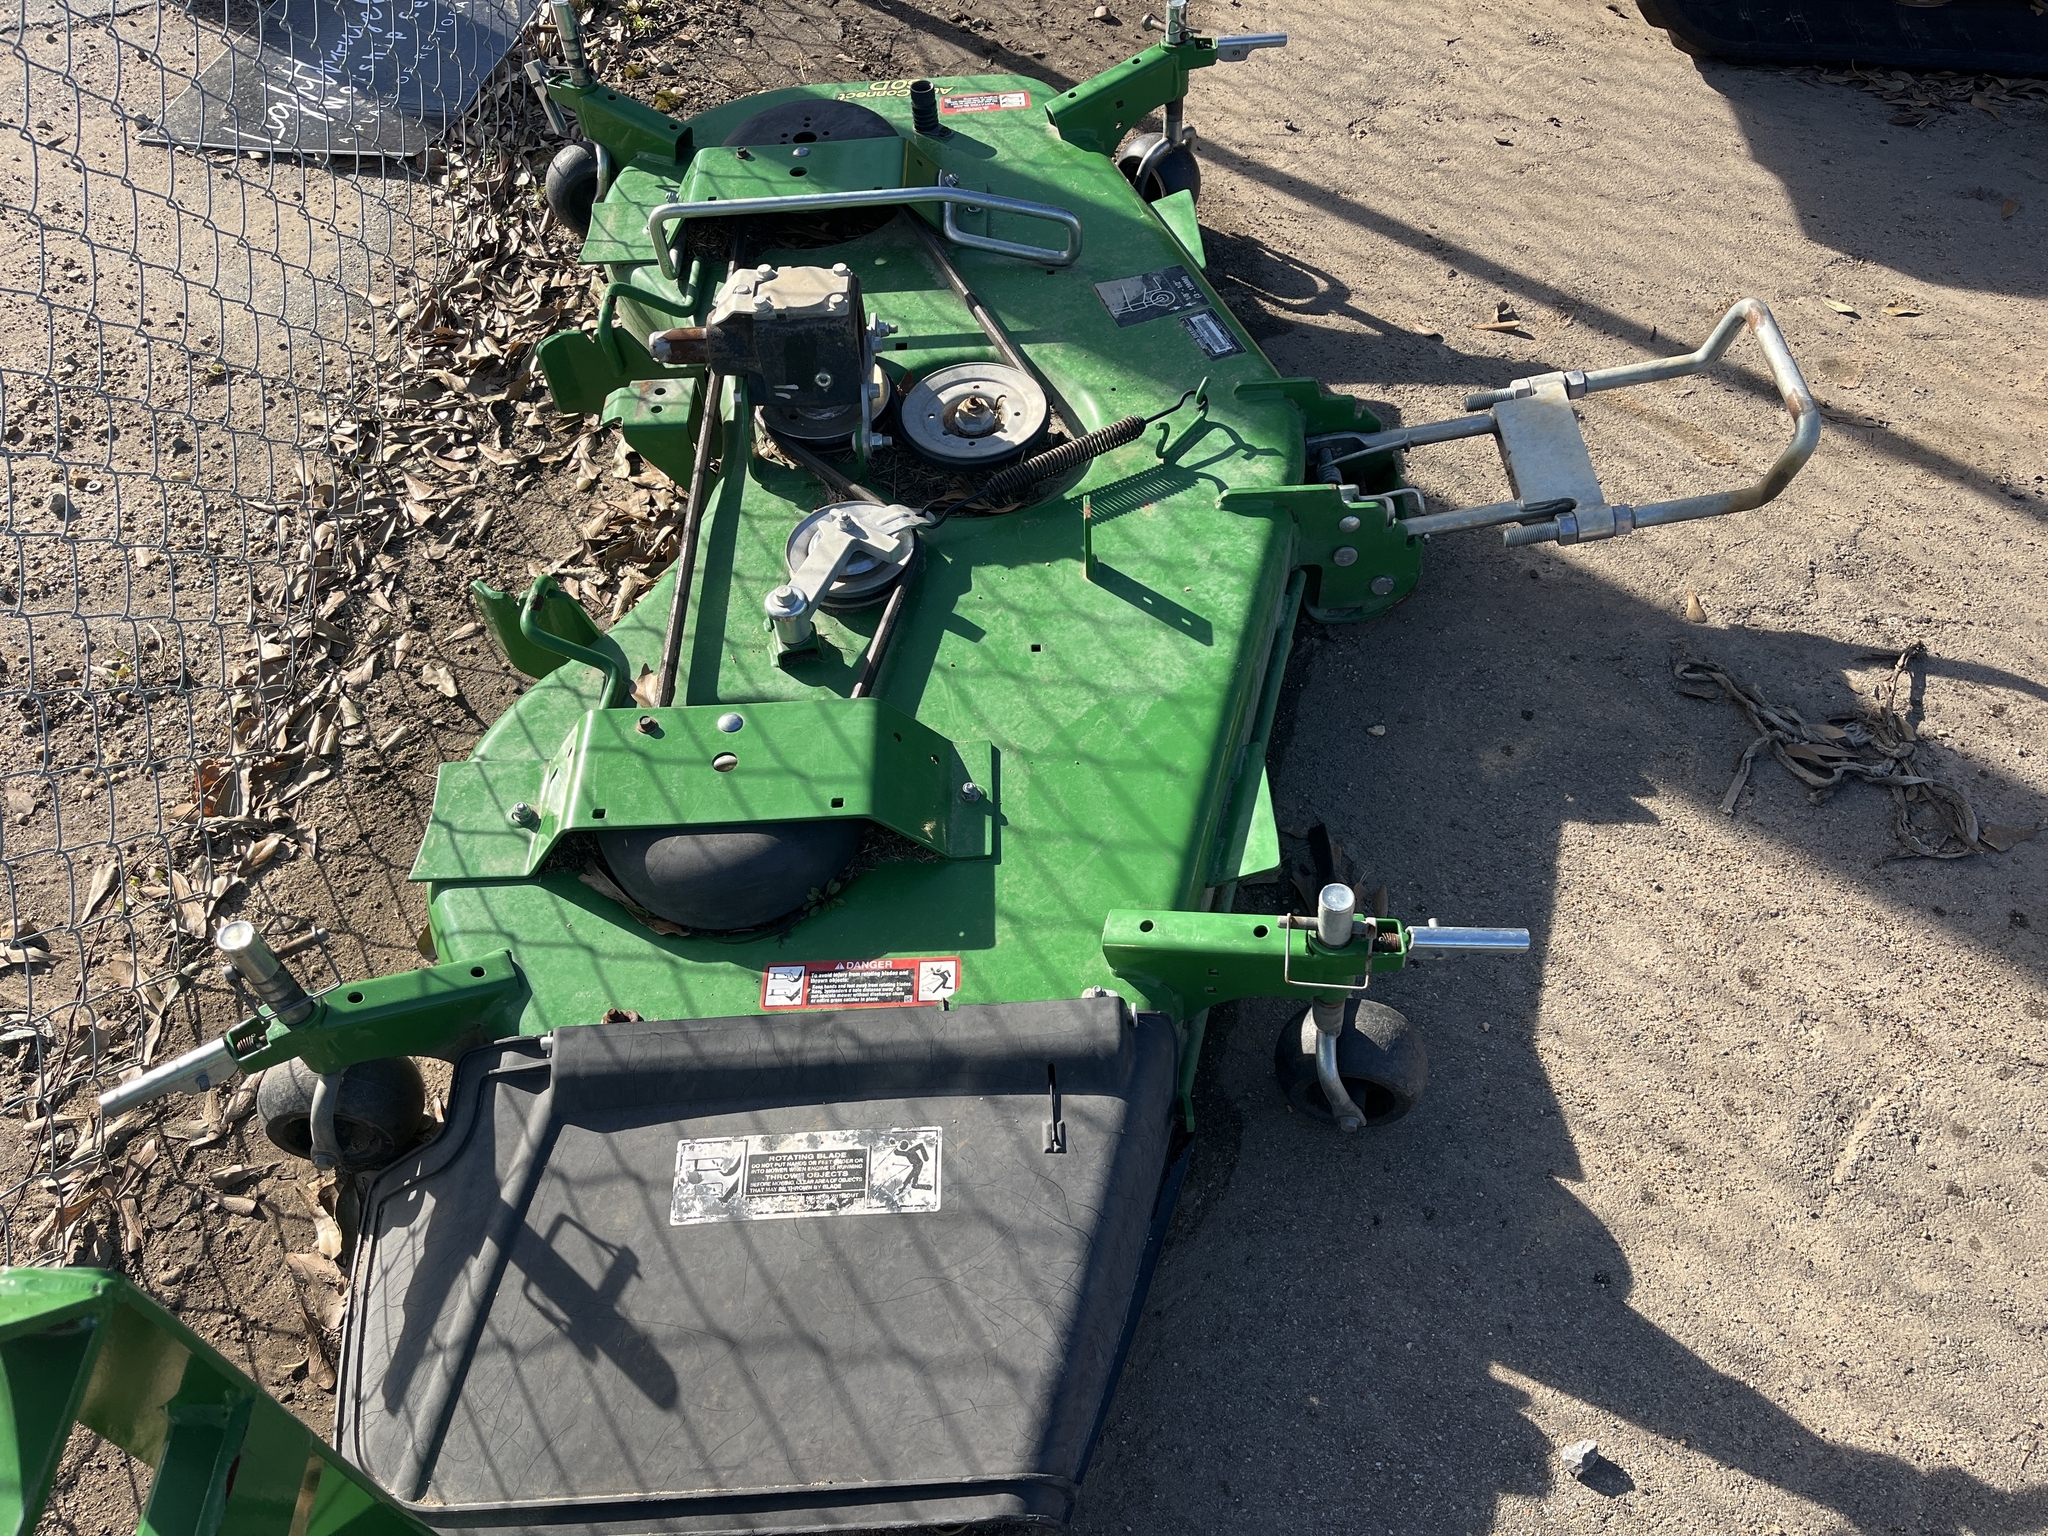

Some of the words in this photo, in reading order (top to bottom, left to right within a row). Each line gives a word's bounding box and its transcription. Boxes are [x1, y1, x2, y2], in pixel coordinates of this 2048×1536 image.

[318, 30, 408, 110] Worship
[351, 92, 400, 132] PLACE
[847, 961, 893, 969] DANGER
[769, 1153, 814, 1162] ROTATING
